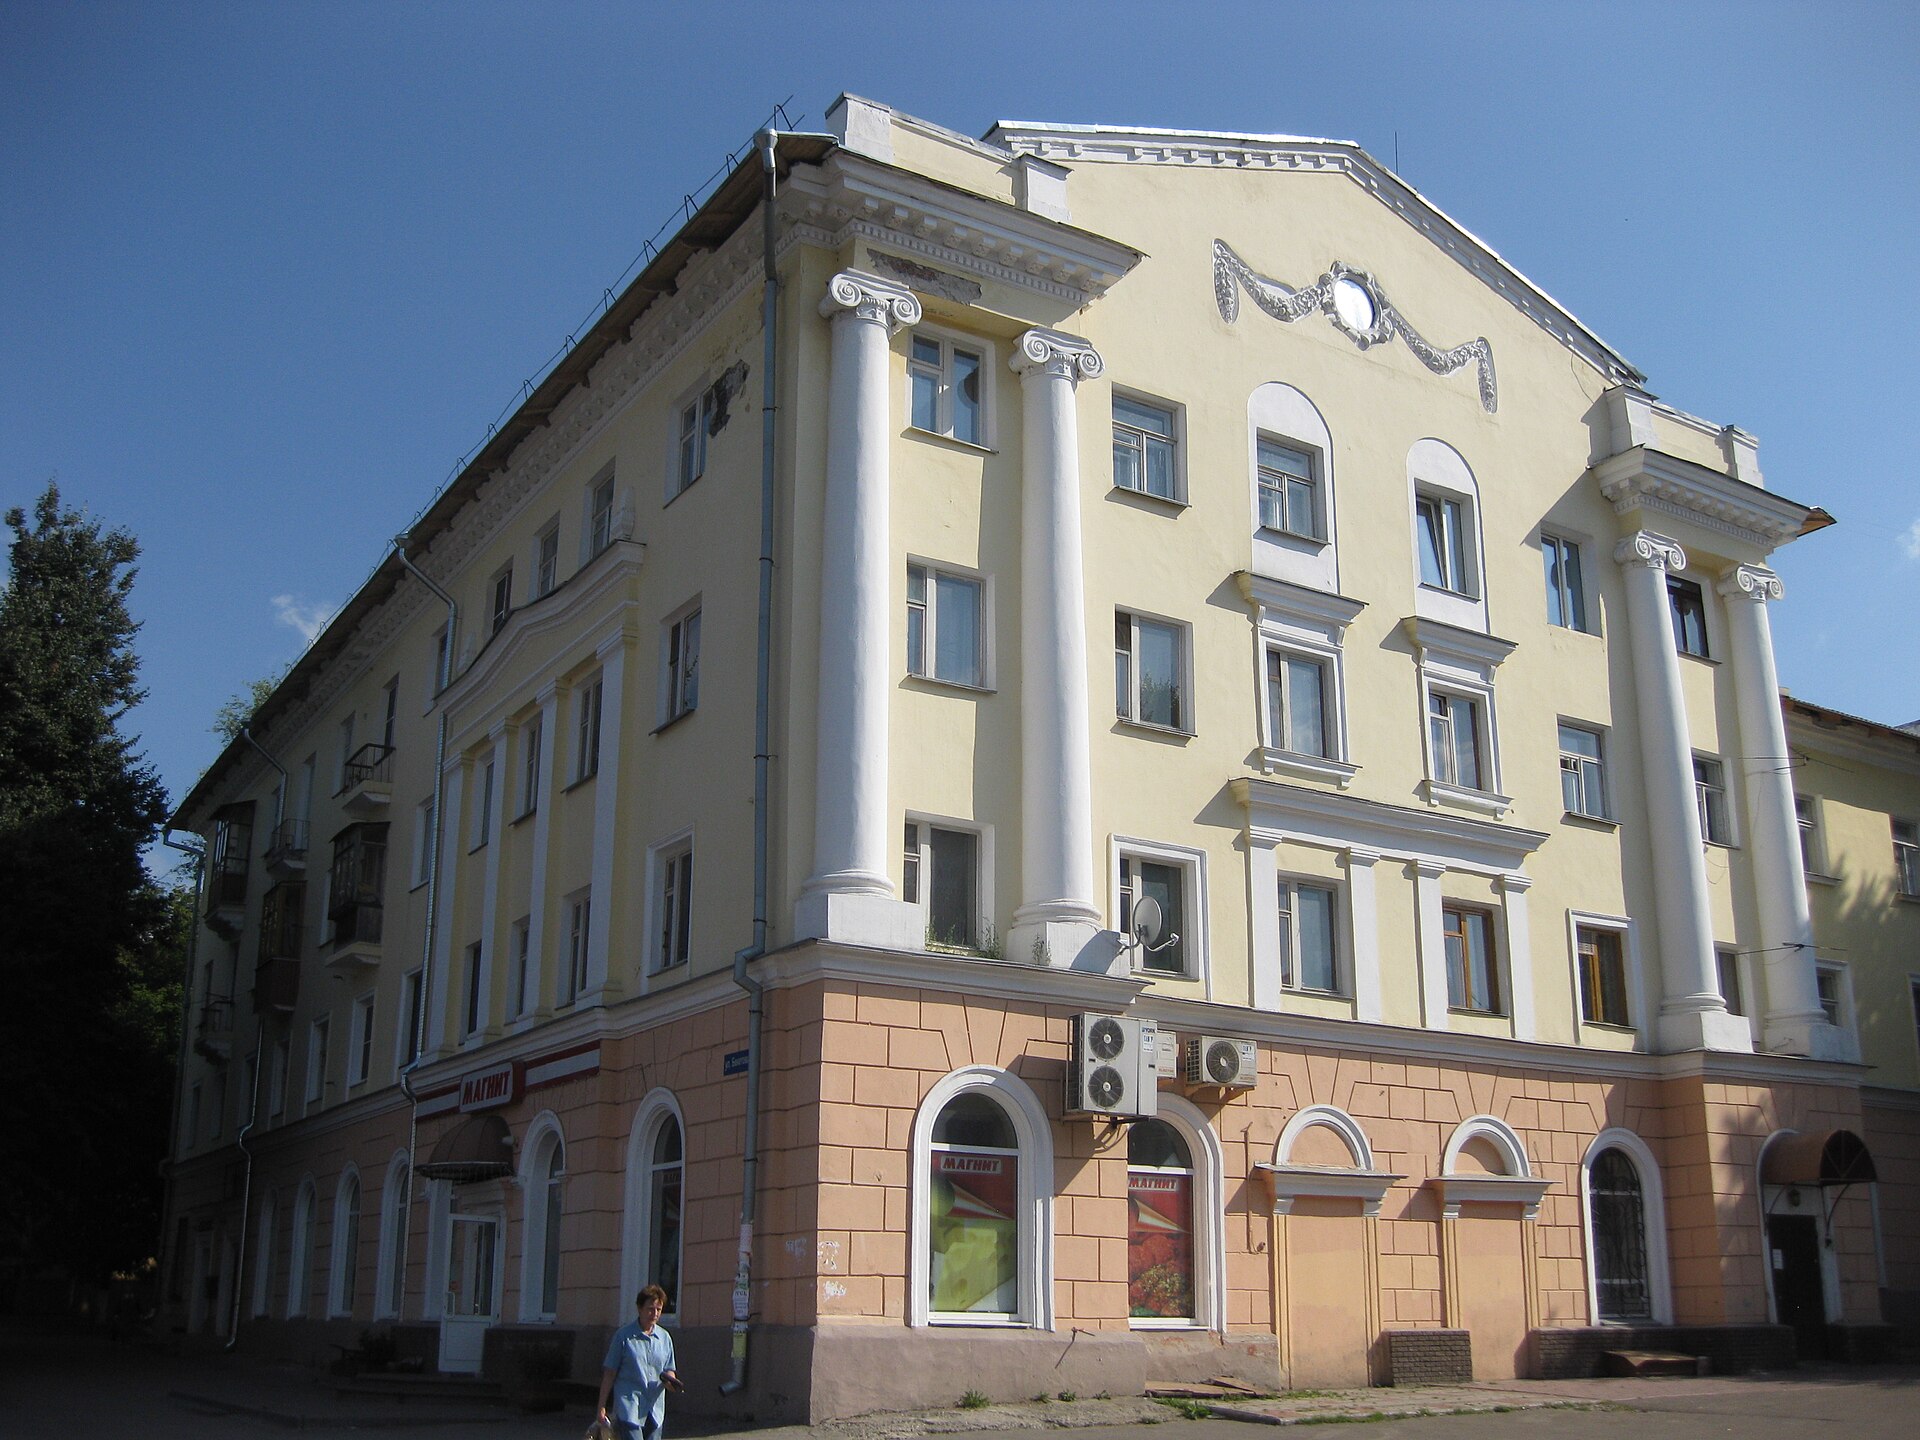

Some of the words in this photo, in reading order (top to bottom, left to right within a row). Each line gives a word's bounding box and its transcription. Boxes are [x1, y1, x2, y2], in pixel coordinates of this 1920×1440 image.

[462, 1071, 510, 1105] МАГНИТ
[942, 1157, 1000, 1171] МАГНИТ
[1129, 1177, 1177, 1189] МАГНИТ
